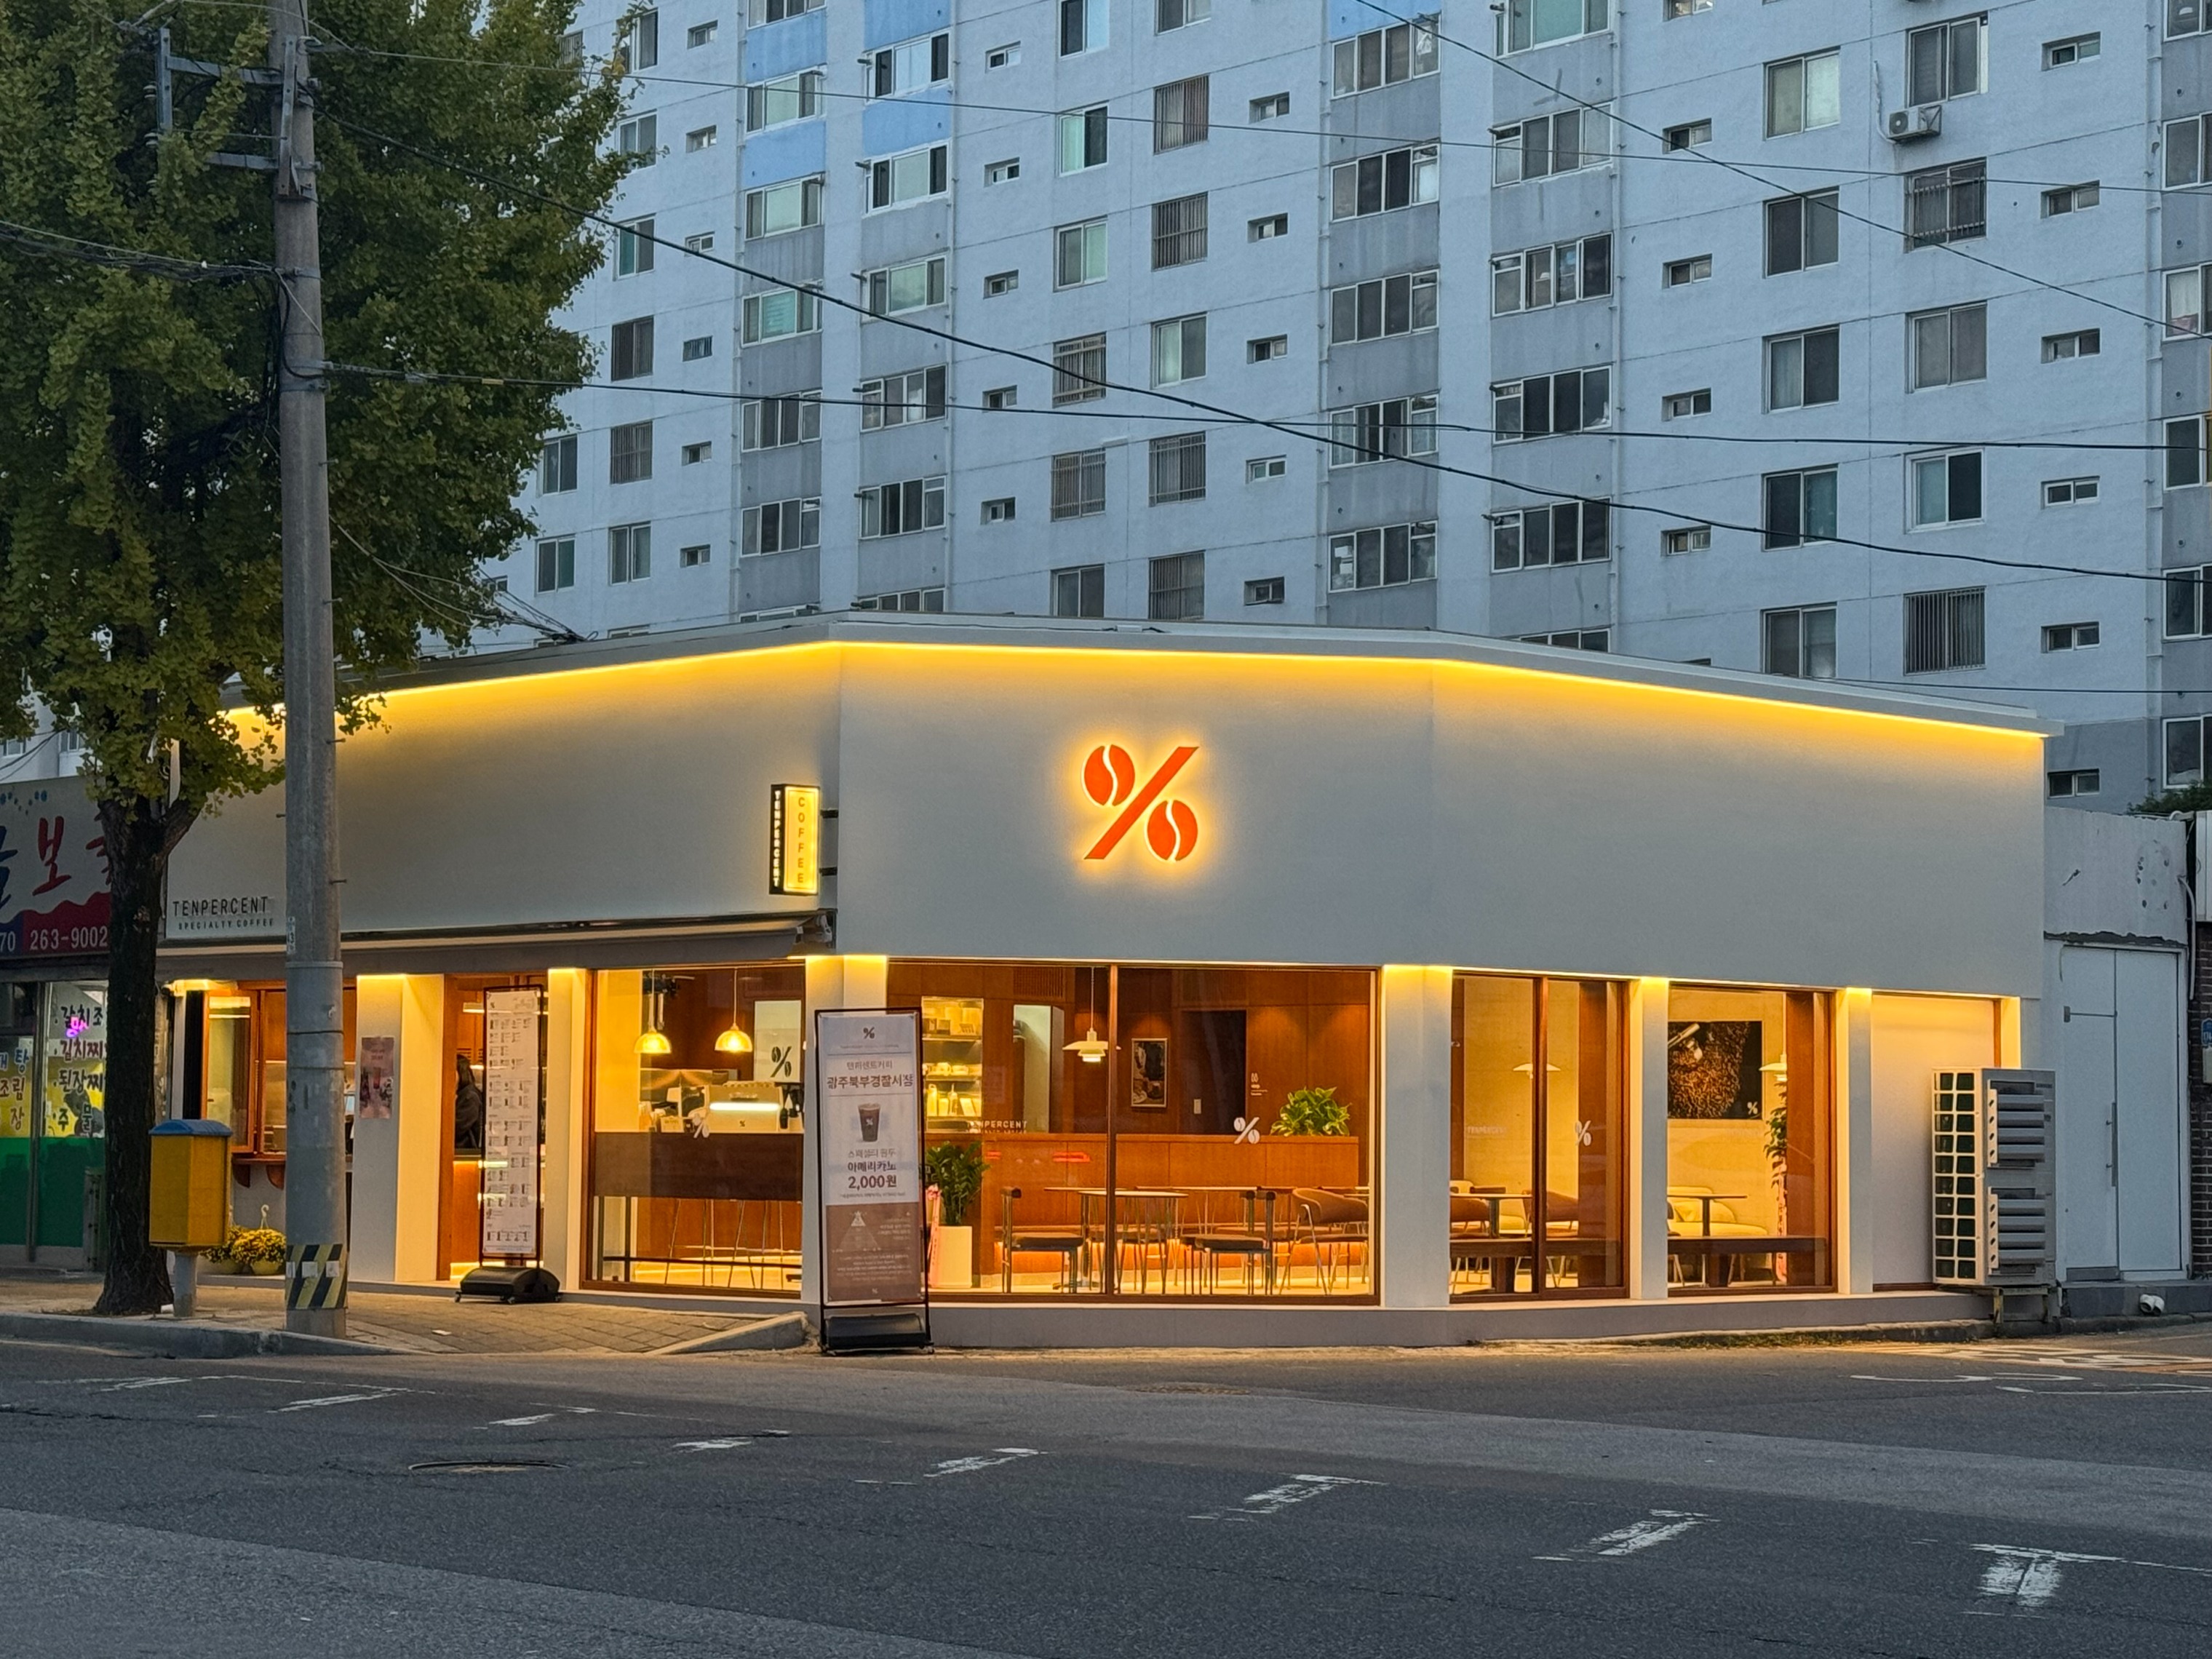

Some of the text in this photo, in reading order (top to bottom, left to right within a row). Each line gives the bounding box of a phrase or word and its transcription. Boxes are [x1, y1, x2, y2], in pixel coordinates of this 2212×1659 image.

[773, 790, 781, 887] TENPERCENT
[797, 797, 805, 883] COFFEE
[172, 896, 268, 917] TENPERCENT
[178, 918, 274, 931] SPECIALTY COFFEE
[30, 926, 108, 950] 263-9002
[60, 1037, 108, 1062] 김치찌
[58, 1068, 108, 1093] 된장찌
[848, 1160, 897, 1173] 아메리카노
[848, 1174, 897, 1191] 2,000원
